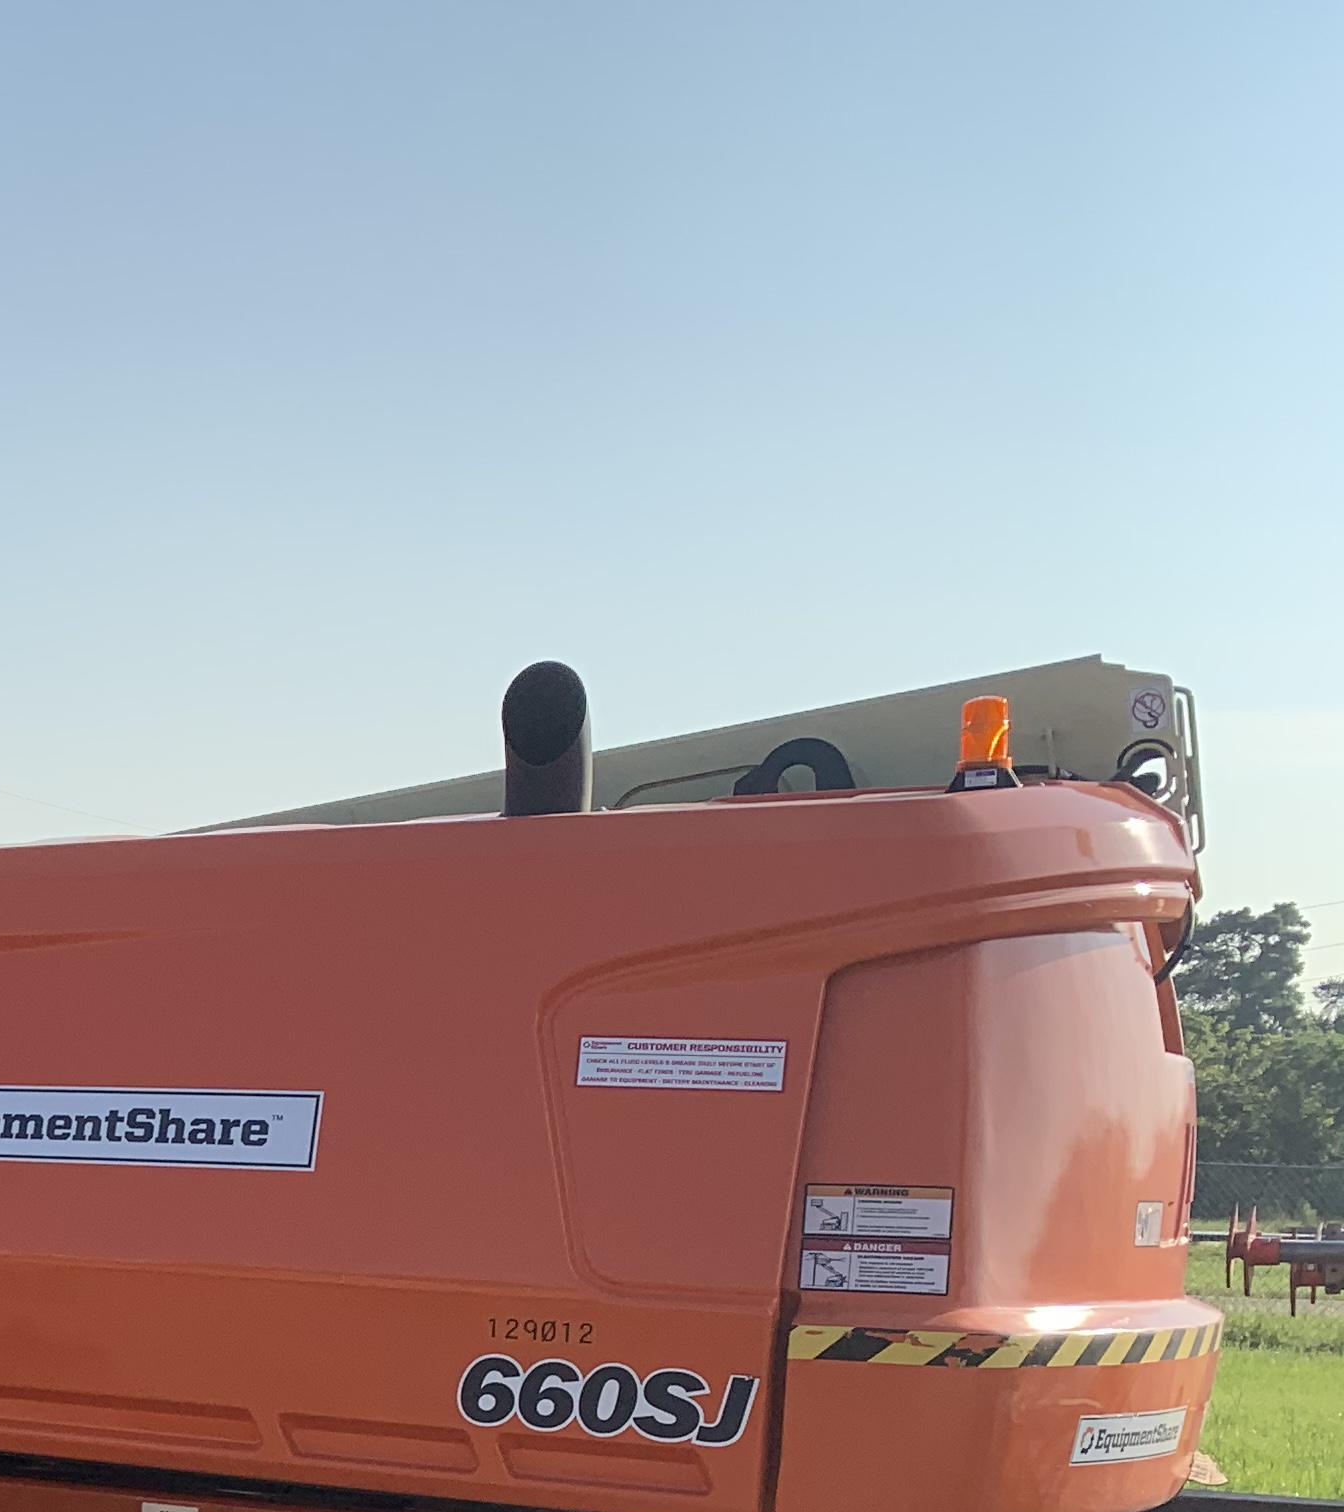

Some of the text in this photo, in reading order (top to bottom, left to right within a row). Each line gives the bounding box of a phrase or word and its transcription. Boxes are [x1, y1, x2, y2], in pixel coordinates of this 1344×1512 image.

[627, 1042, 687, 1051] CUSTOMER
[689, 1043, 784, 1053] RESPONSIBILITY
[854, 1187, 910, 1197] WARNING
[853, 1242, 902, 1252] DANGER
[488, 1318, 594, 1344] 129012
[458, 1355, 759, 1447] 660SJ
[1094, 1423, 1180, 1453] EquipmentShare
